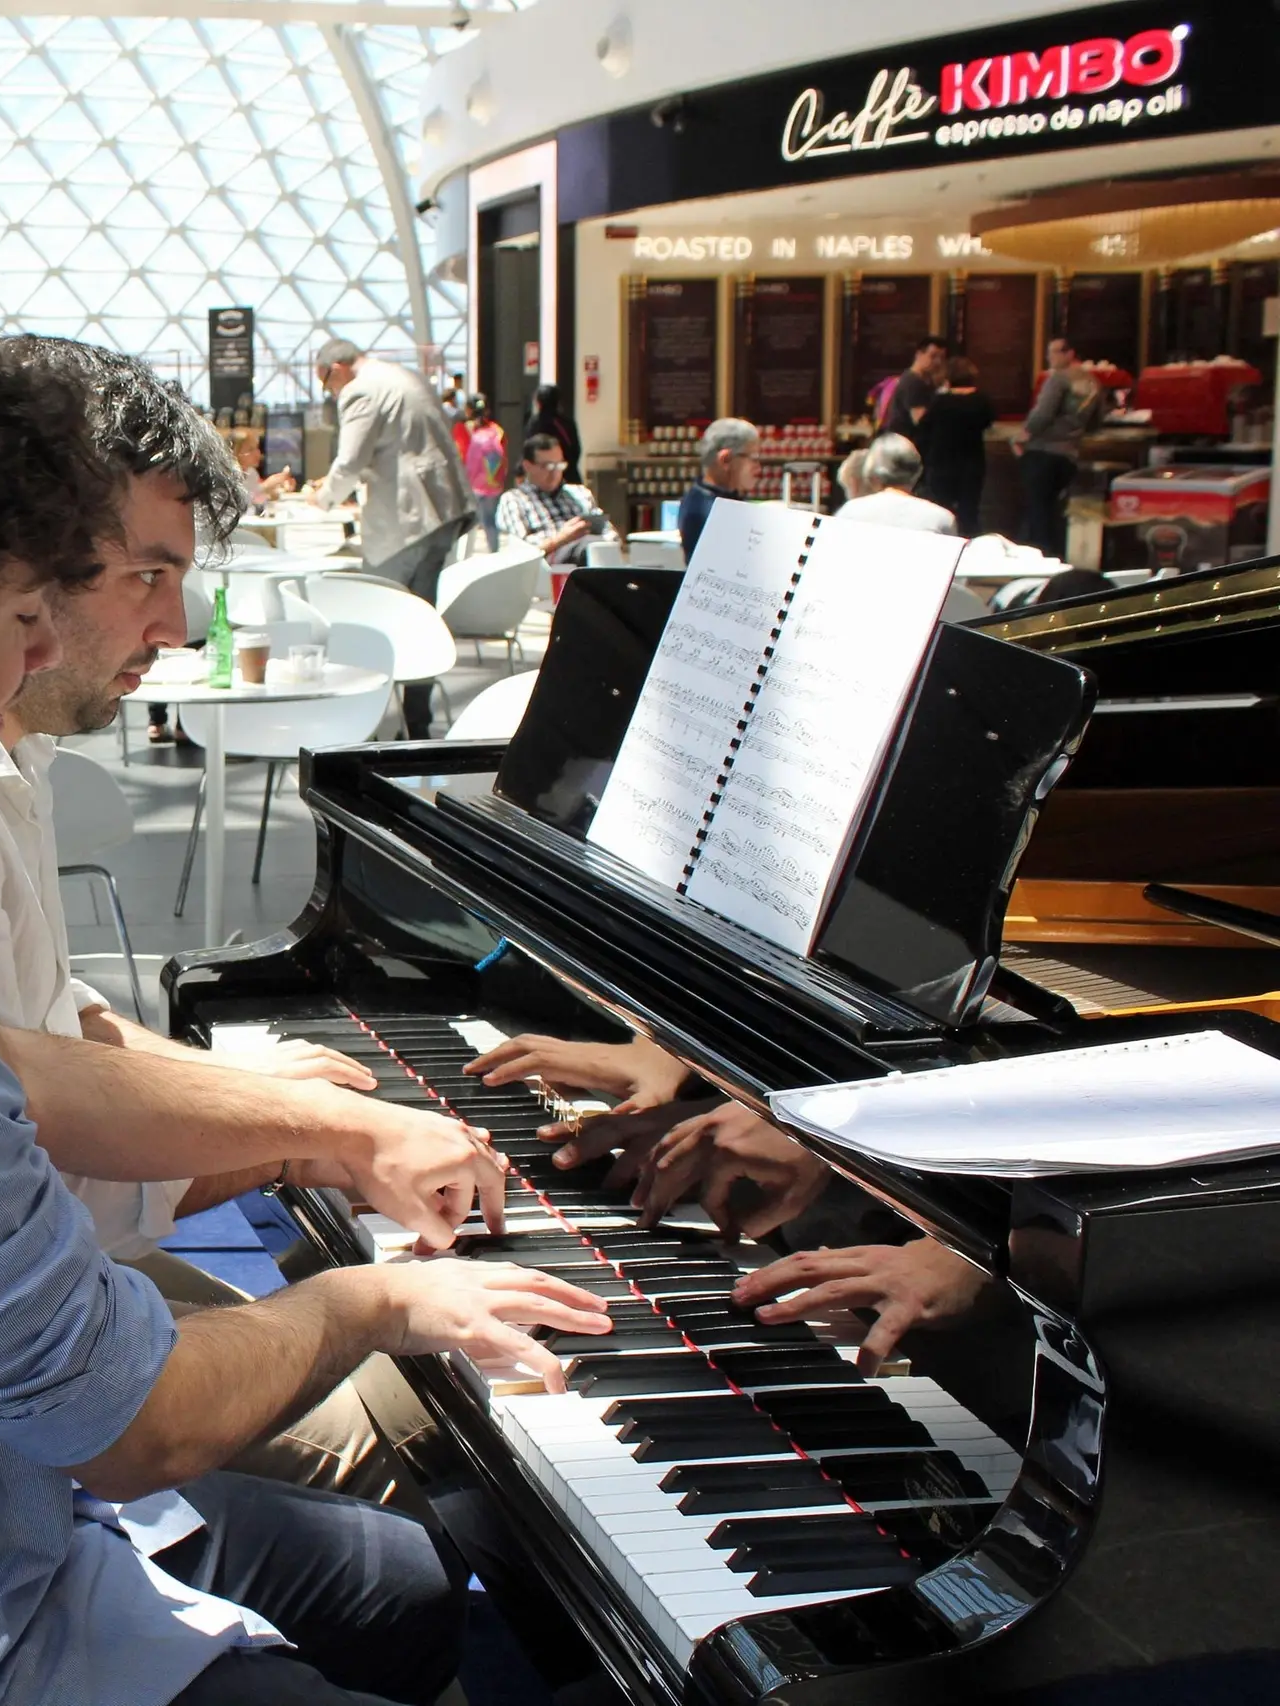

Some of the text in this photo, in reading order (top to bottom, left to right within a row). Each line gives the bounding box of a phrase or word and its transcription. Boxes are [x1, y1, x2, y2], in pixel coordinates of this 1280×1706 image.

[940, 24, 1191, 115] KIMBO
[935, 112, 1047, 147] espresso
[1050, 104, 1084, 130] da
[634, 236, 752, 261] ROASTED
[772, 238, 796, 259] IN
[817, 234, 913, 260] NAPLES
